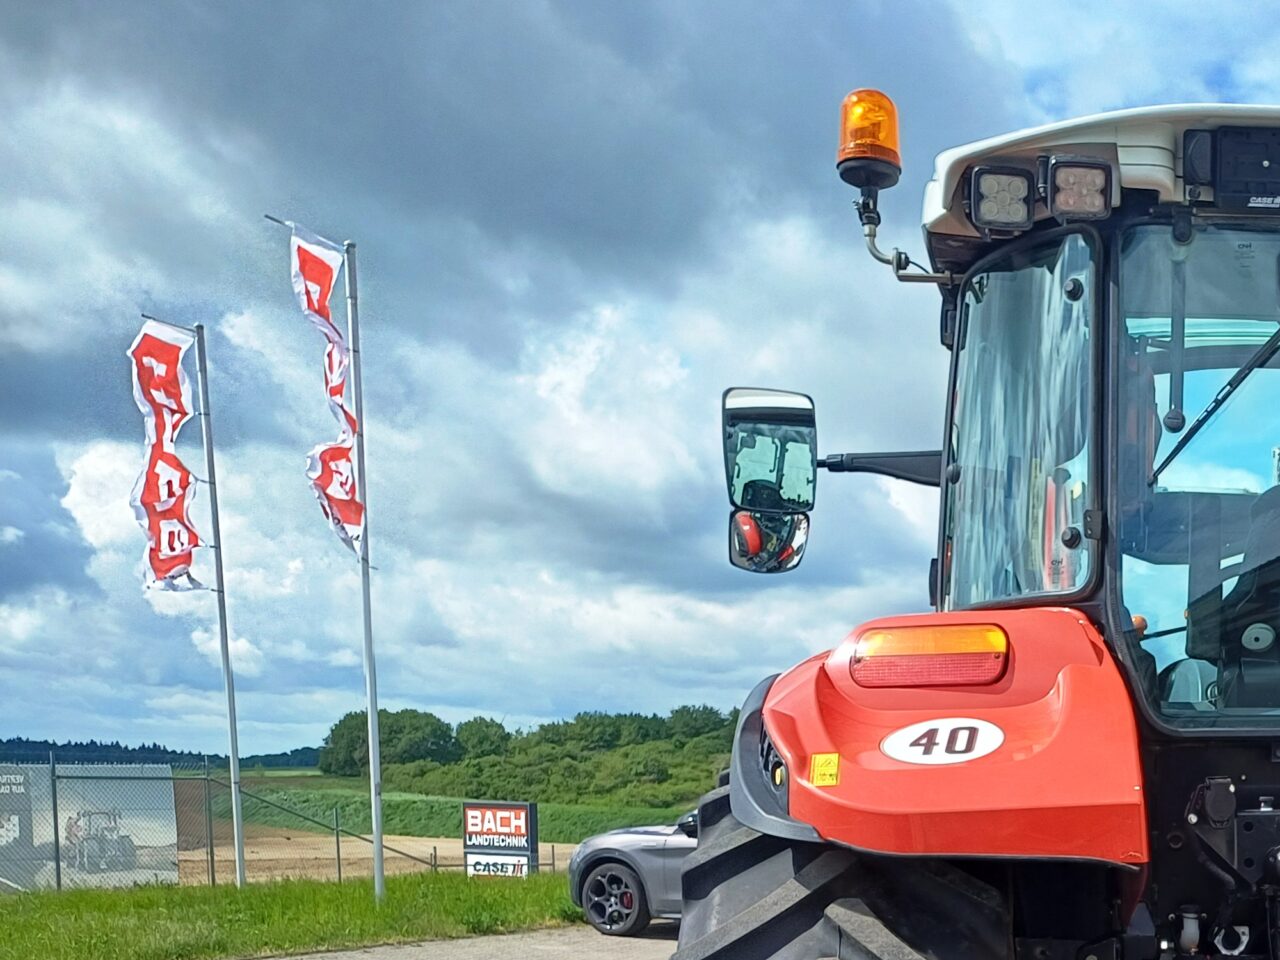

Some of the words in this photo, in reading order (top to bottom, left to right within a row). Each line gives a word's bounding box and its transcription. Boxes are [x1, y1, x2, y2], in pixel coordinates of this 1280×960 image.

[908, 726, 979, 755] 40
[467, 810, 526, 834] BACH
[466, 833, 528, 847] LANDTECHNIK
[473, 861, 509, 873] CASE
